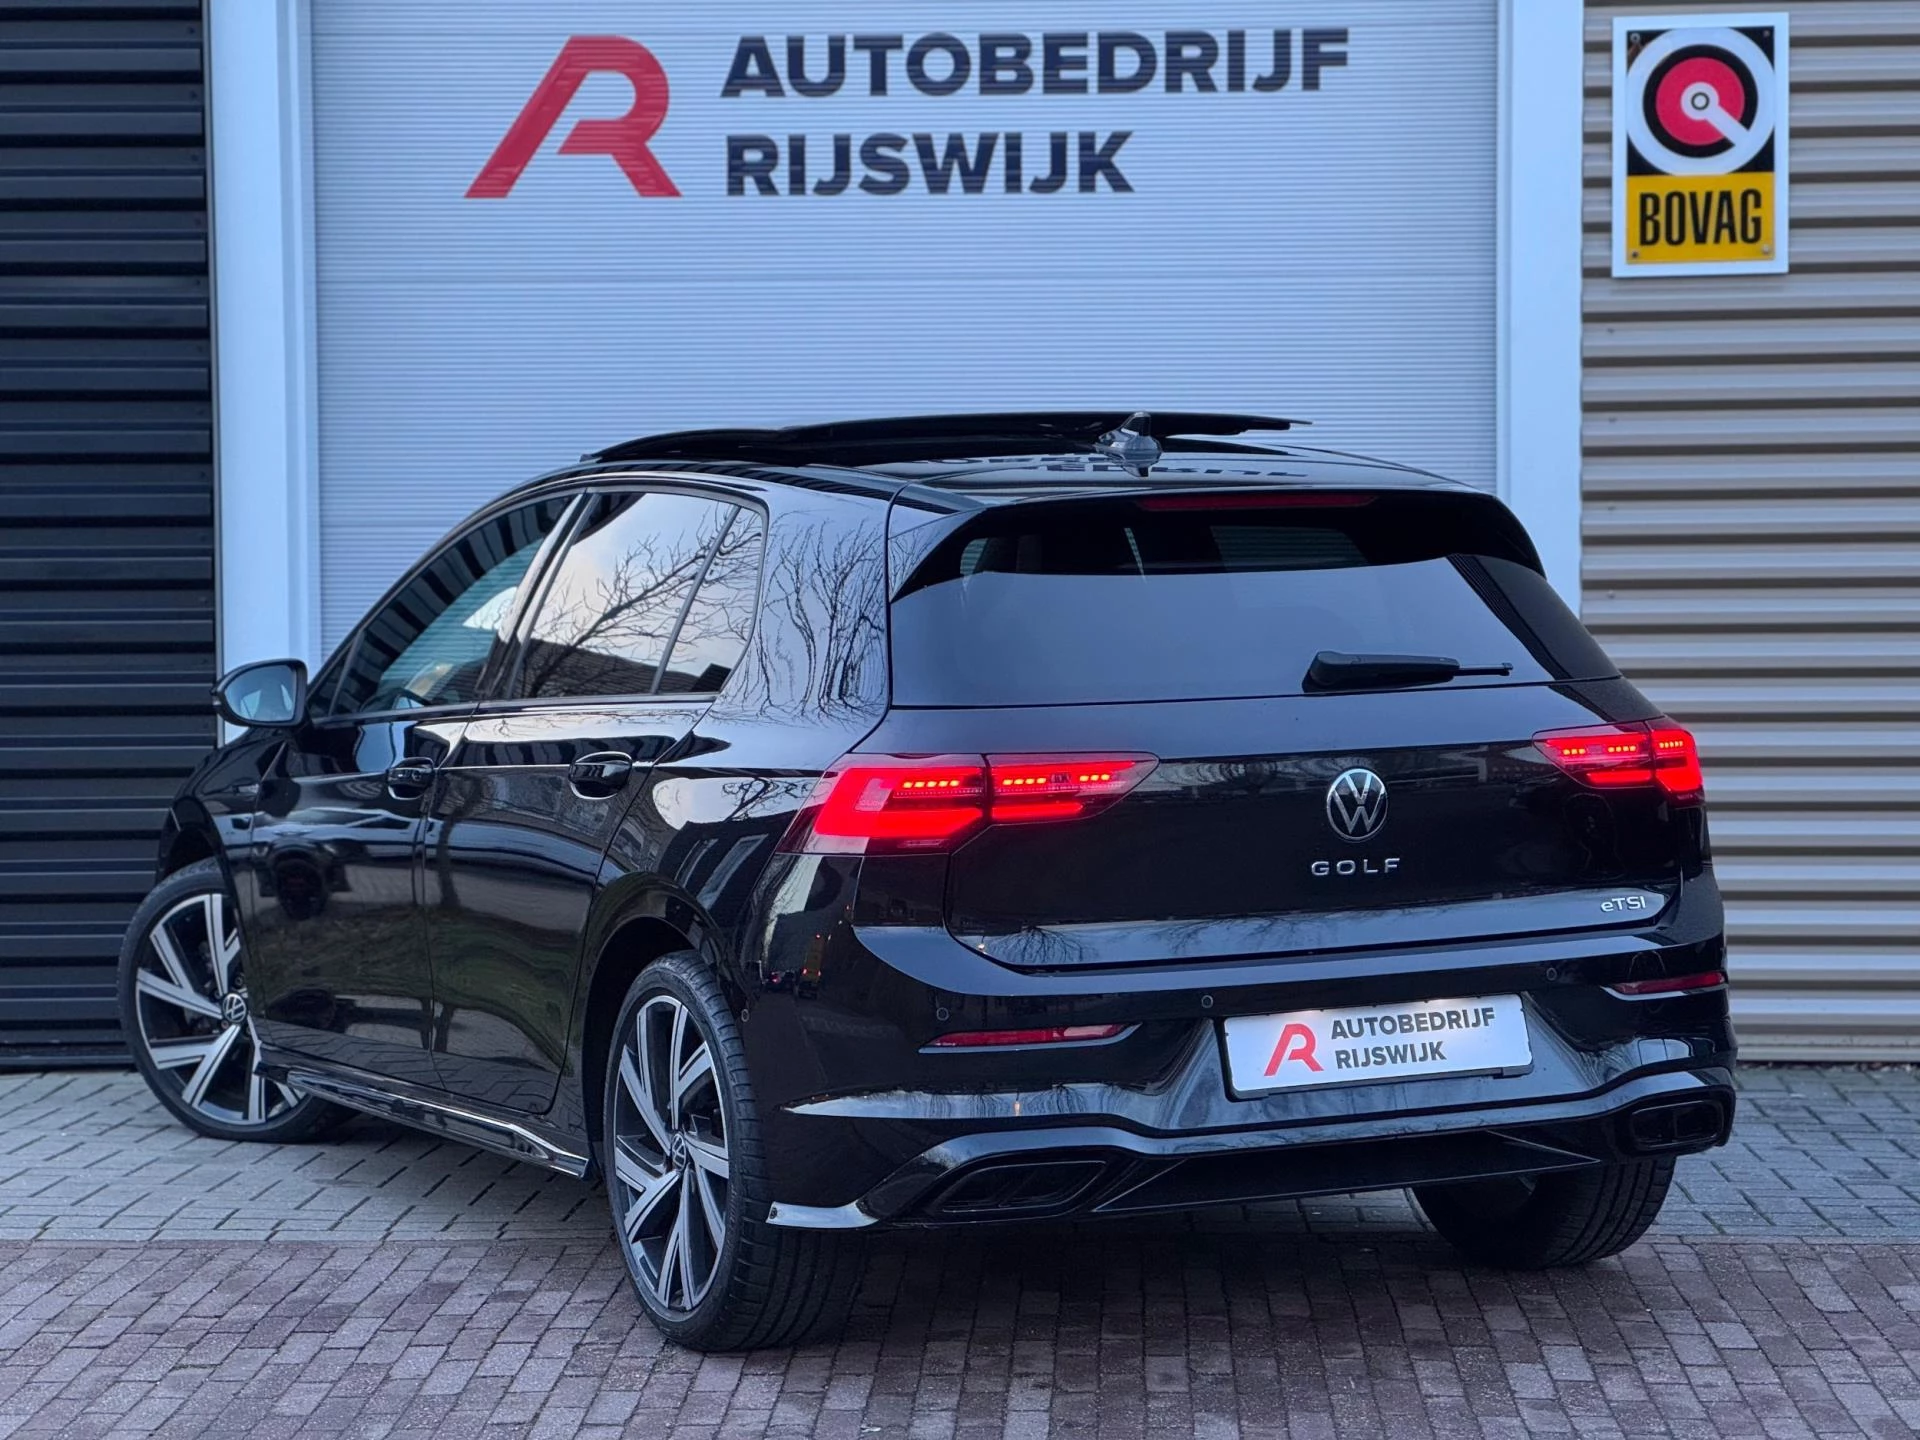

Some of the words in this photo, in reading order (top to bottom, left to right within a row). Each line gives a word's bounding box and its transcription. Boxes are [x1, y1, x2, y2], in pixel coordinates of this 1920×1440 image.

[720, 28, 1349, 99] AUTOBEDRIJF
[726, 130, 1136, 197] RIJSWIJK
[1639, 188, 1762, 247] BOVAG
[1311, 857, 1400, 876] GOLF
[1601, 895, 1646, 913] eTSI
[1331, 1007, 1495, 1041] AUTOBEDRIJF
[1335, 1041, 1447, 1070] RIJSWIJK
